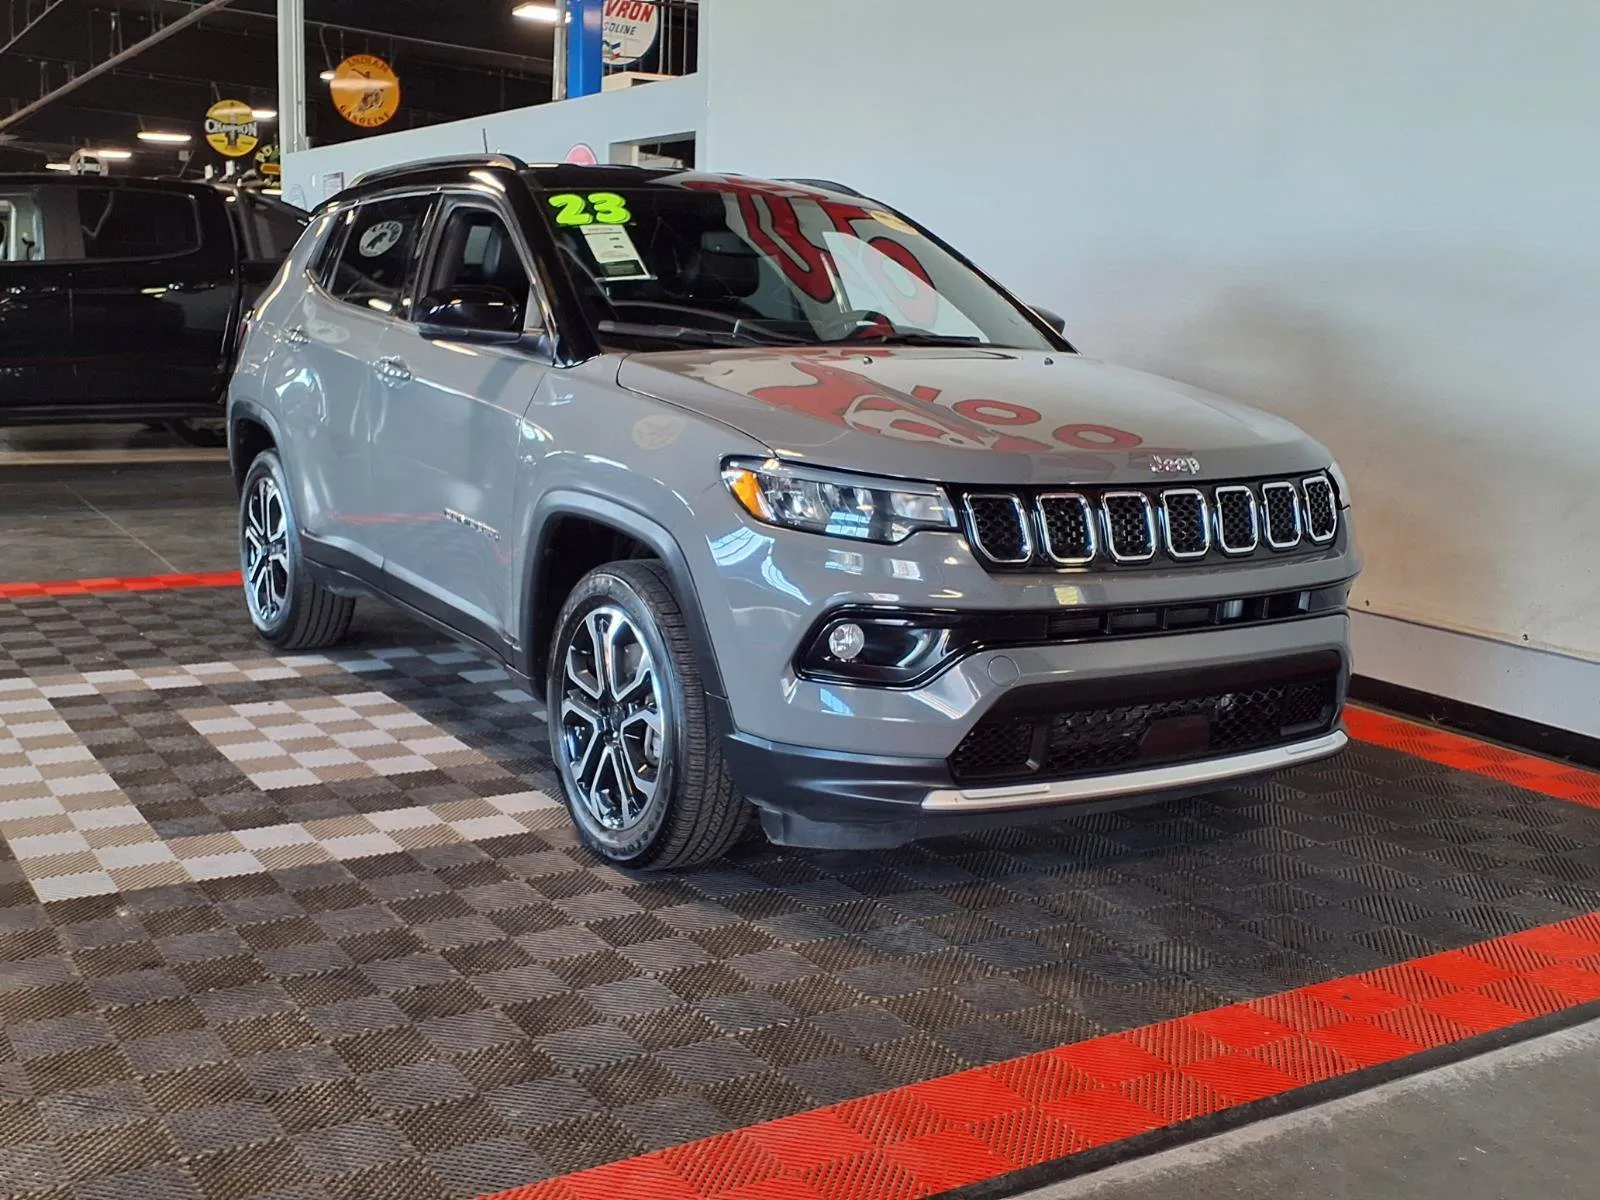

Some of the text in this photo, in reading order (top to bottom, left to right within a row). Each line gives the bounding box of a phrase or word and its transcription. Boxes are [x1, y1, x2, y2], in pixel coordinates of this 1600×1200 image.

[604, 0, 655, 22] VRON
[603, 22, 637, 36] SOLINE
[548, 192, 631, 225] 23
[1149, 455, 1200, 475] Jeep
